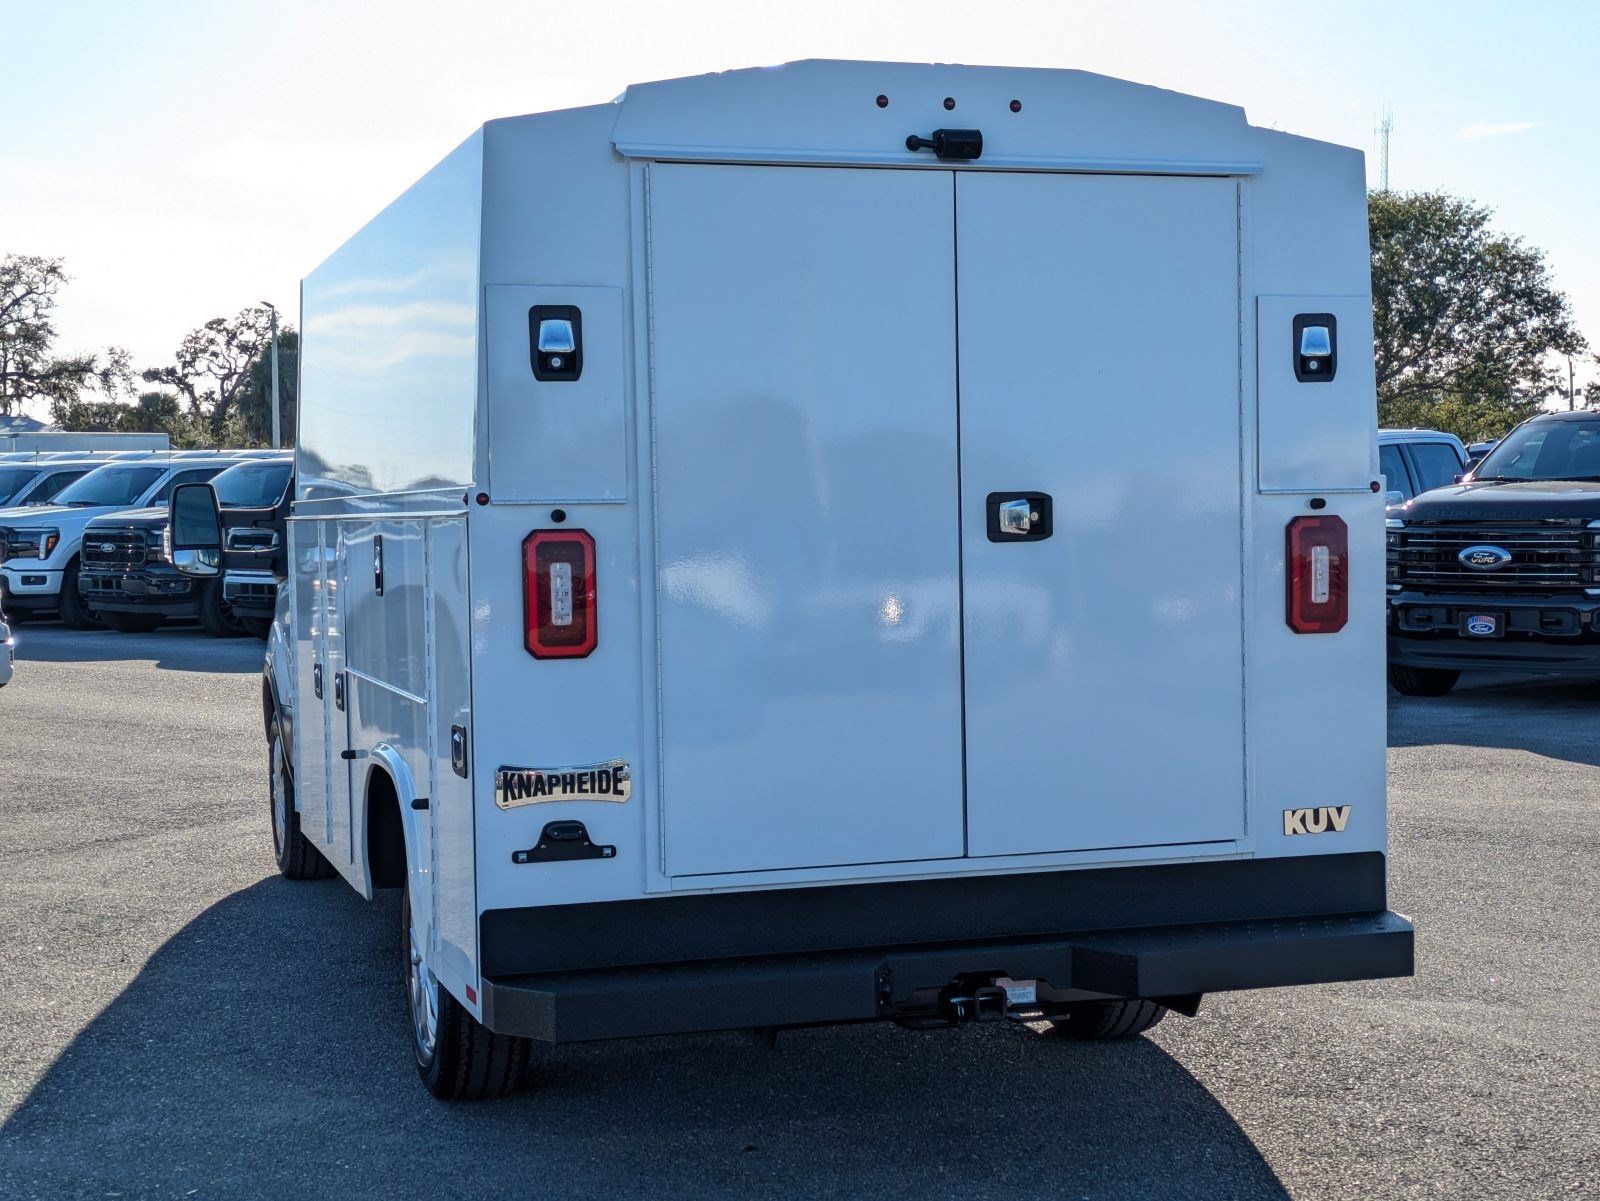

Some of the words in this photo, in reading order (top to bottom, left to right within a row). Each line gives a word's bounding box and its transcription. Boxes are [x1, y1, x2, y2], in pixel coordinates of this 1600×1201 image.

[1471, 552, 1496, 563] Ford
[502, 765, 625, 802] KNAPHEIDE
[1283, 805, 1352, 836] KUV
